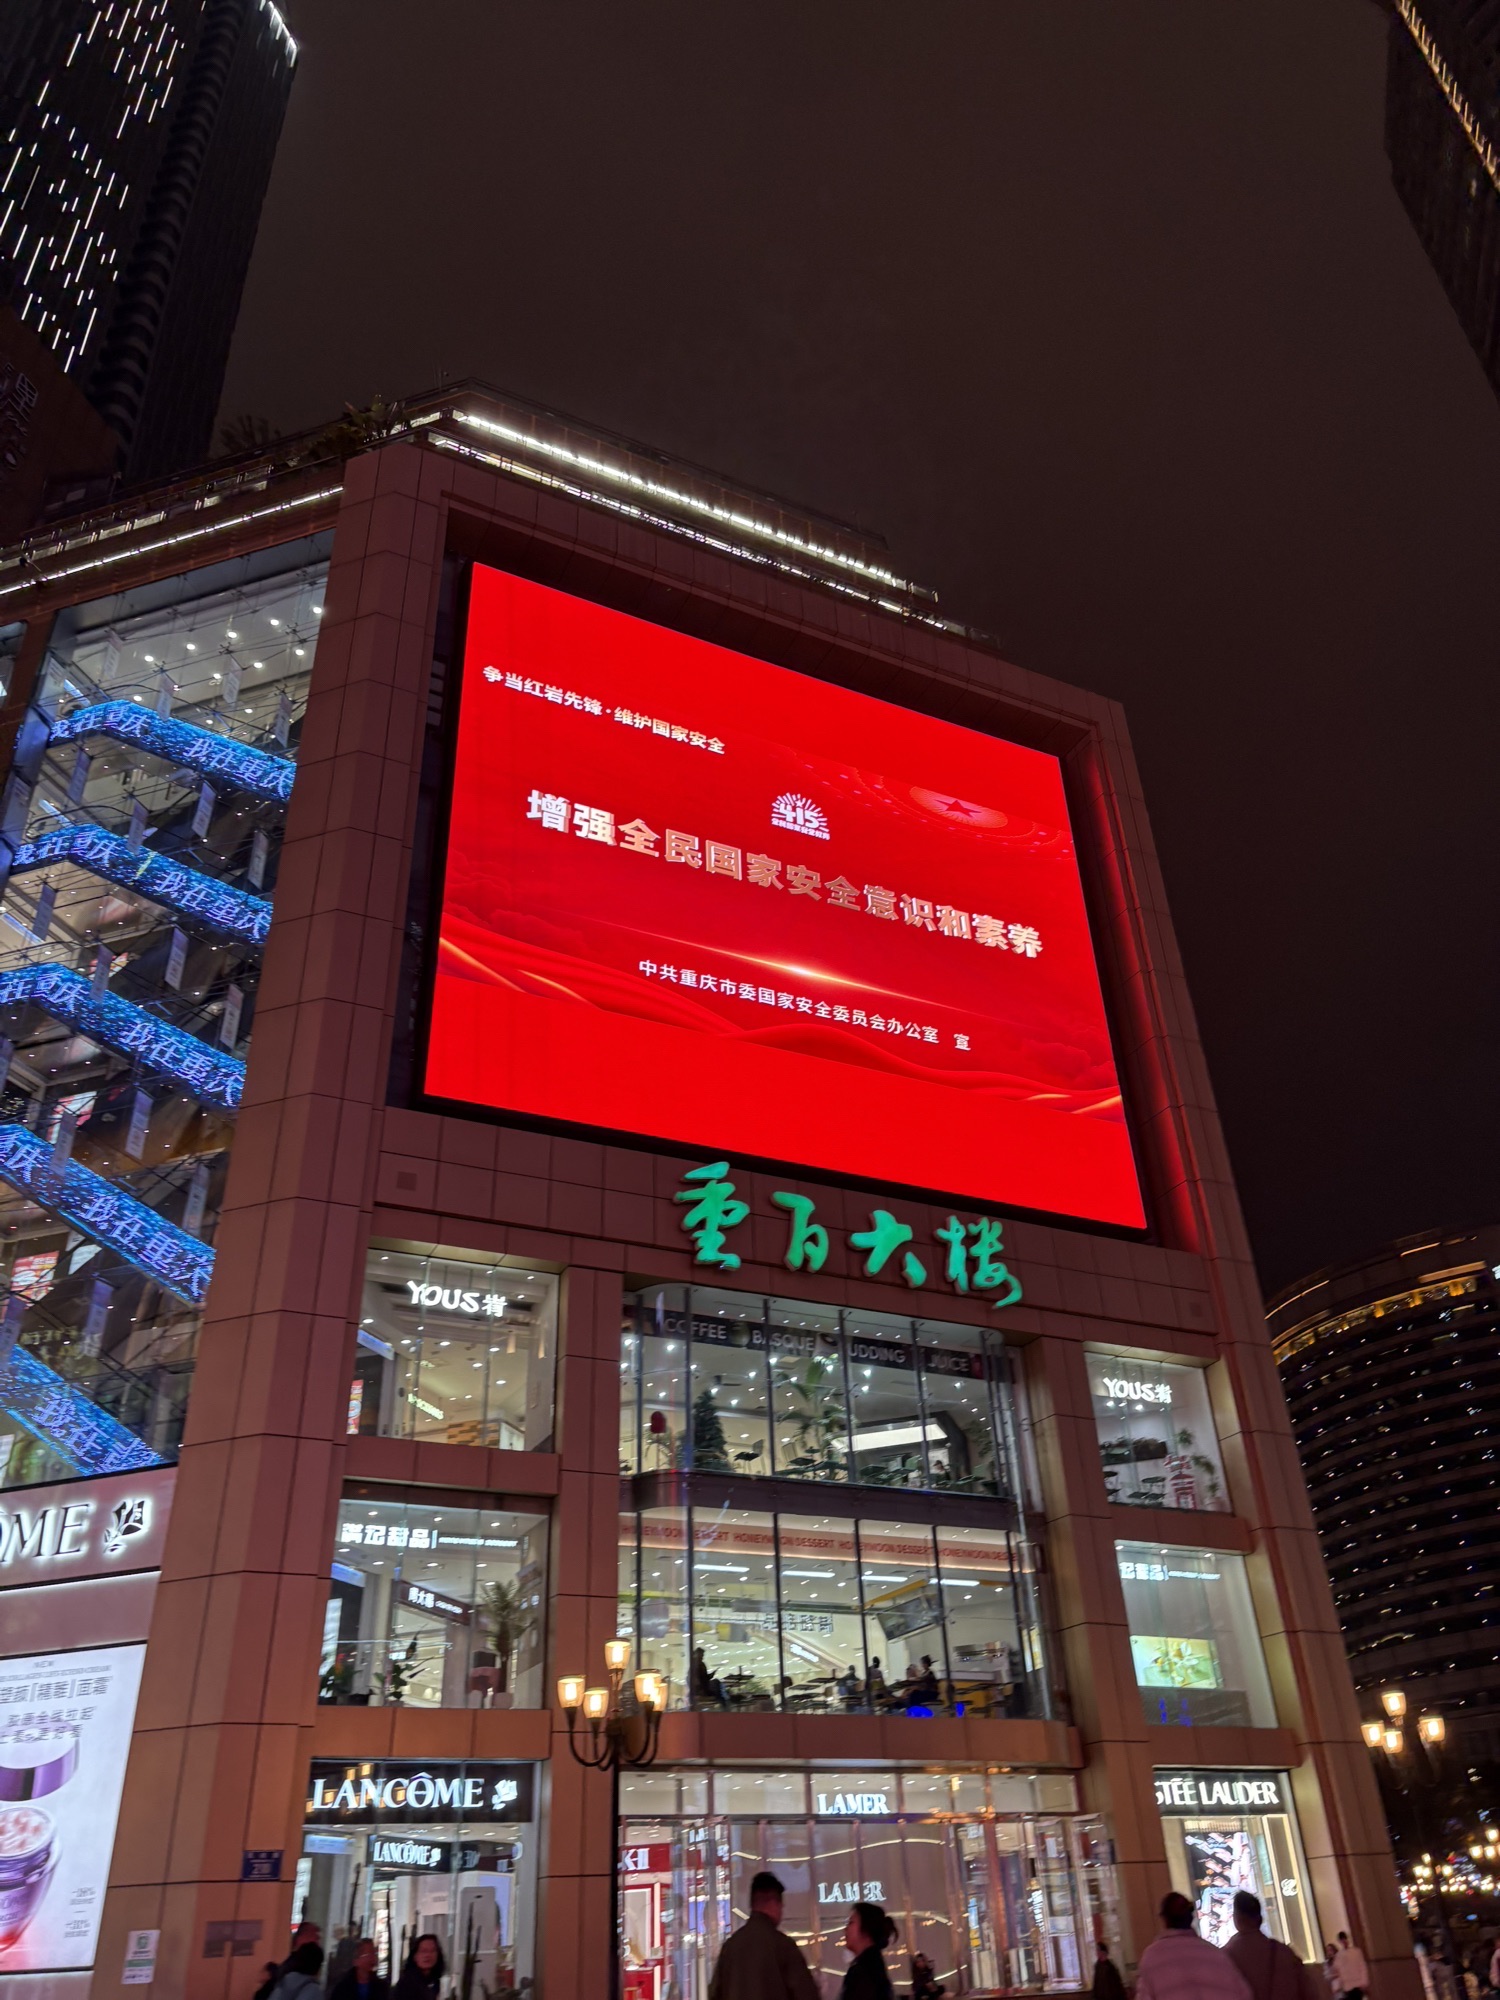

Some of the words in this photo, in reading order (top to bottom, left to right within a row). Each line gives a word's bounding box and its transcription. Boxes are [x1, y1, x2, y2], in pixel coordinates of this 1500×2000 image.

[483, 665, 725, 755] 争当红岩先锋·维护国家安全
[526, 790, 1044, 958] 增强全民国家安全意识和素养
[638, 959, 940, 1044] 中共重庆市委国家安全委员会办公室
[674, 1161, 1023, 1308] 重百大楼
[849, 1343, 906, 1364] UDDING
[0, 1502, 92, 1563] ME
[312, 1771, 485, 1810] LANCÔME
[1198, 1781, 1279, 1805] LAUDER
